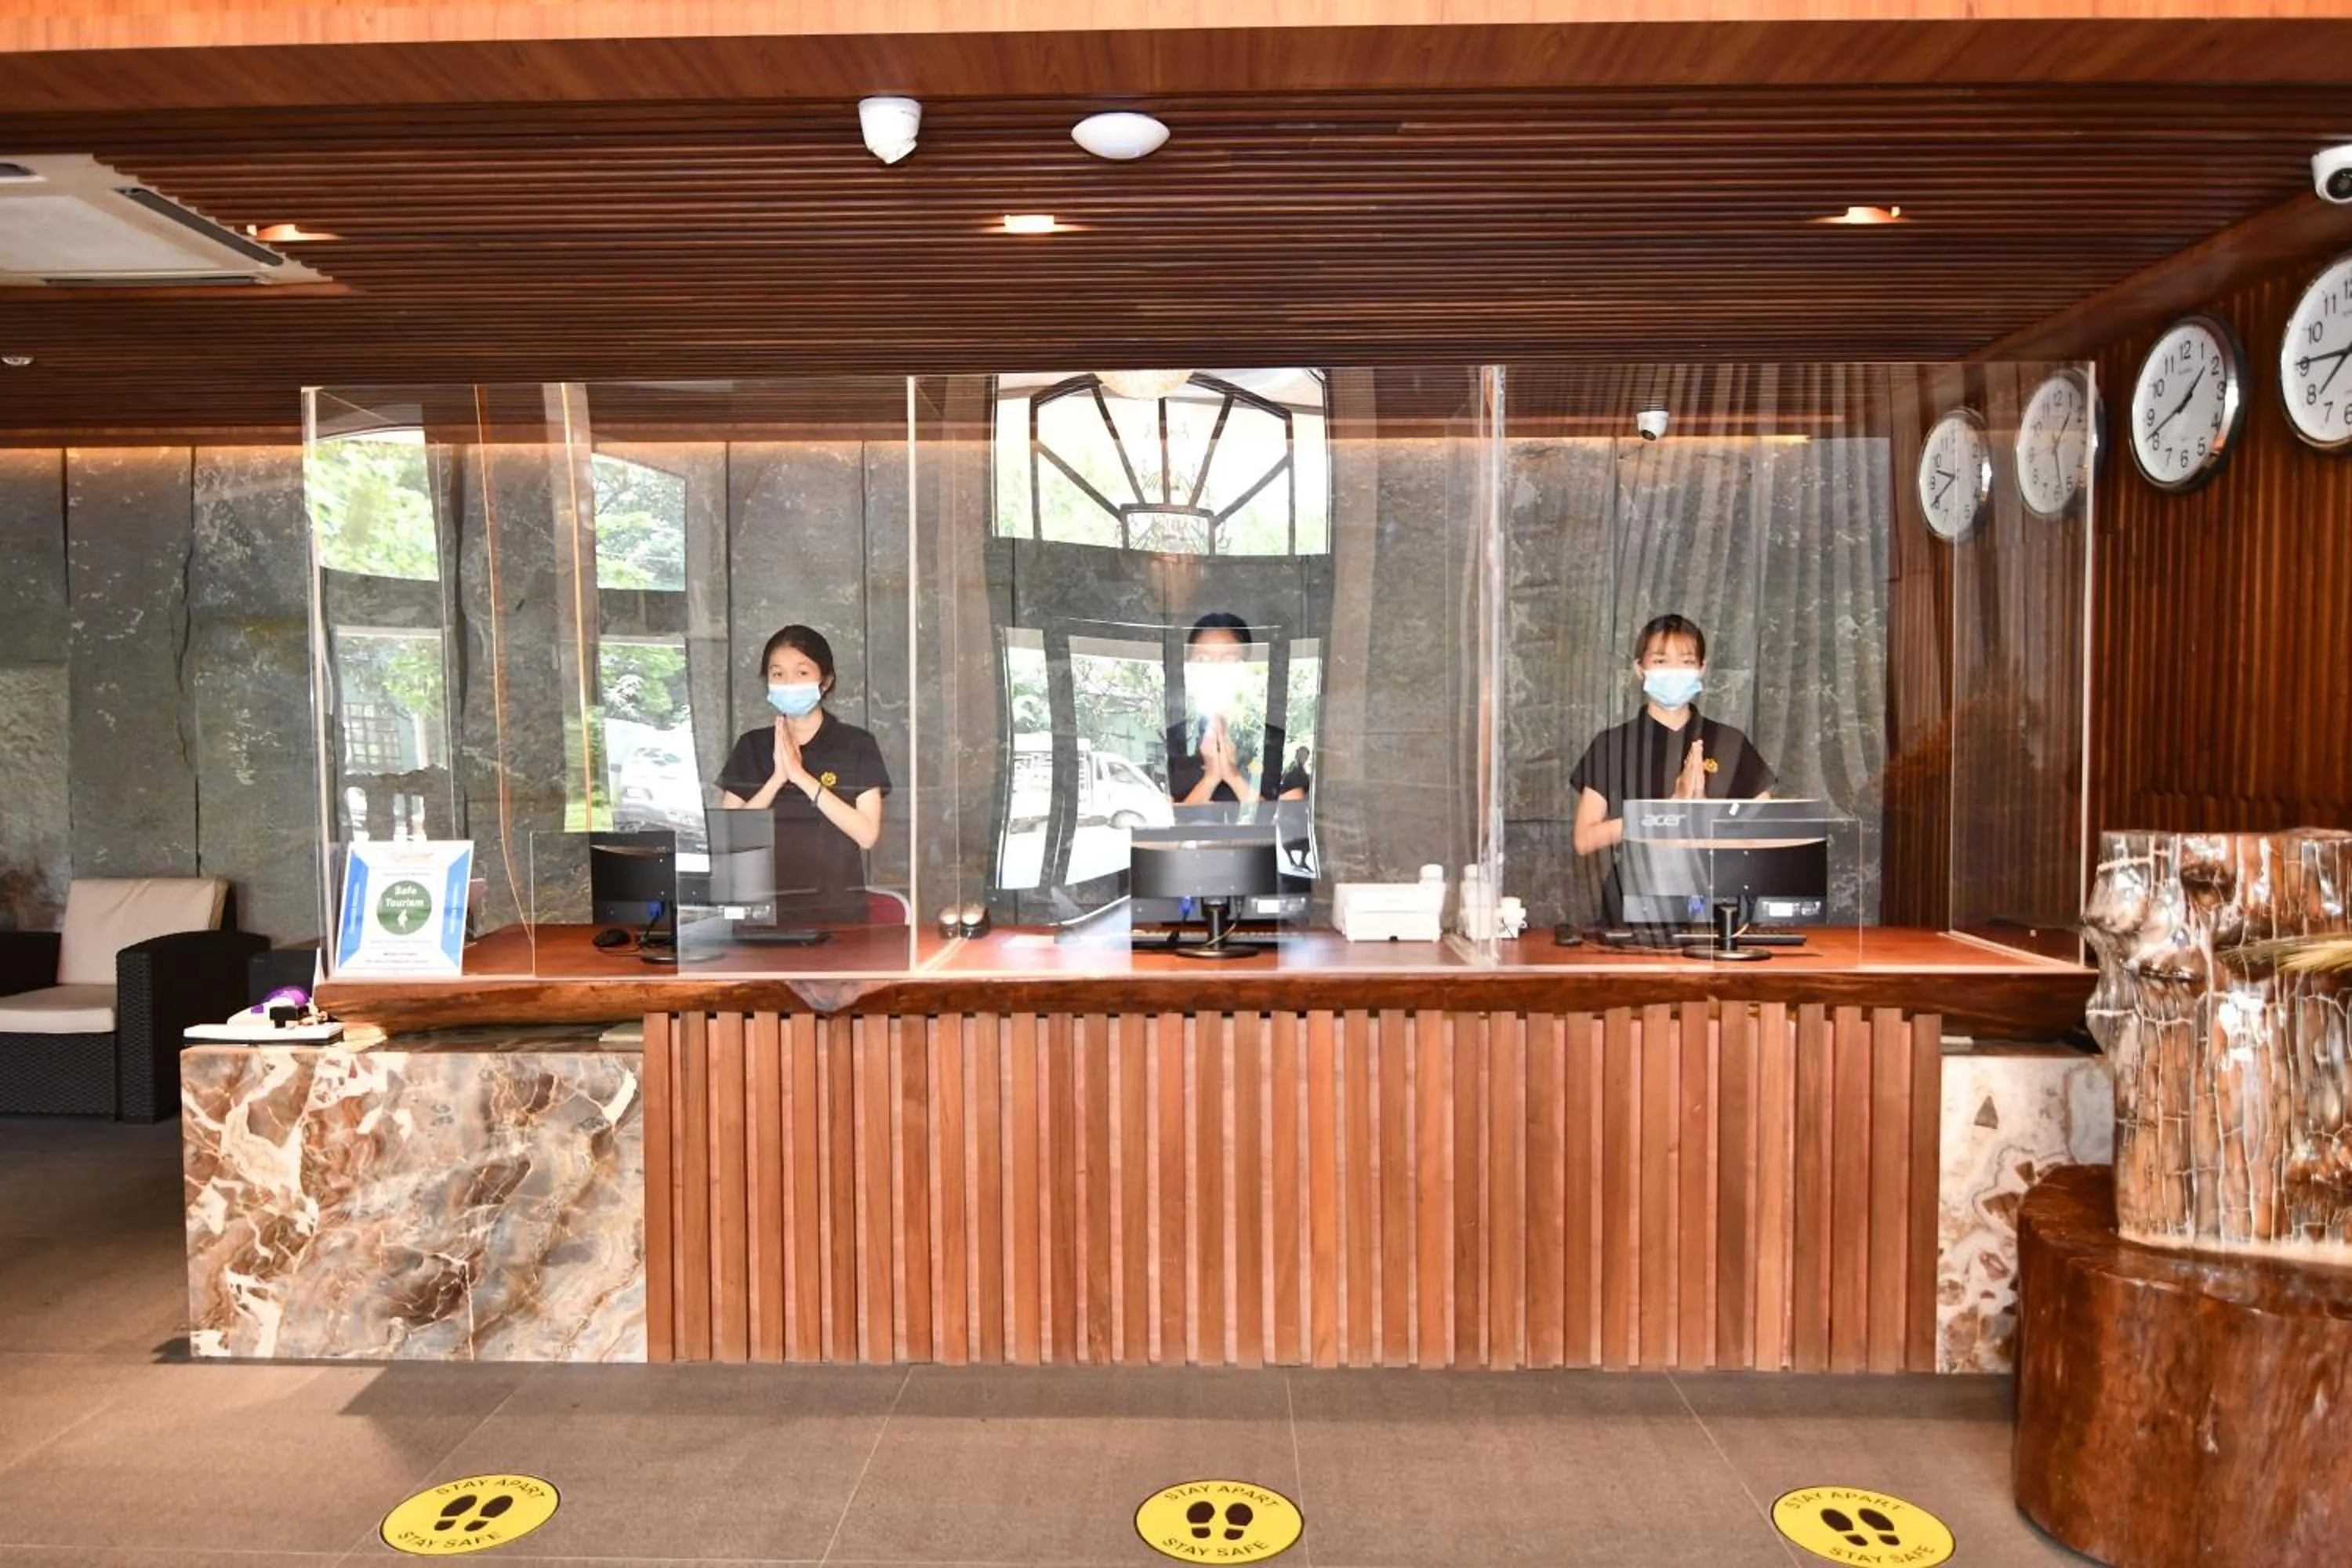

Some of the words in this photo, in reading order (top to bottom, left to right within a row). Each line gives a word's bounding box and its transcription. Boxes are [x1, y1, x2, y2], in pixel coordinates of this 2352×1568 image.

[2324, 293, 2336, 318] 11
[2308, 321, 2323, 344] 10
[2180, 340, 2191, 361] 12
[2165, 355, 2174, 376] 11
[2211, 355, 2220, 376] 2
[2307, 383, 2317, 405] 8
[2147, 408, 2155, 426] 9
[2323, 401, 2333, 423] 7
[2165, 446, 2172, 466] 7
[2197, 436, 2205, 456] 5
[2180, 449, 2189, 468] 6
[1641, 814, 1686, 826] acer
[394, 885, 418, 895] Safe
[436, 1479, 489, 1495] STAY
[494, 1478, 546, 1498] APART
[1163, 1485, 1210, 1501] STAY
[1217, 1485, 1280, 1508] APART
[1784, 1491, 1823, 1510] STAY
[1831, 1491, 1905, 1511] APART
[397, 1530, 437, 1548] STAY
[443, 1531, 503, 1548] SAFE
[1162, 1537, 1210, 1556] STAY
[1217, 1540, 1270, 1557] SAFE
[1829, 1546, 1882, 1563] STAY
[1889, 1544, 1936, 1563] SAFE
